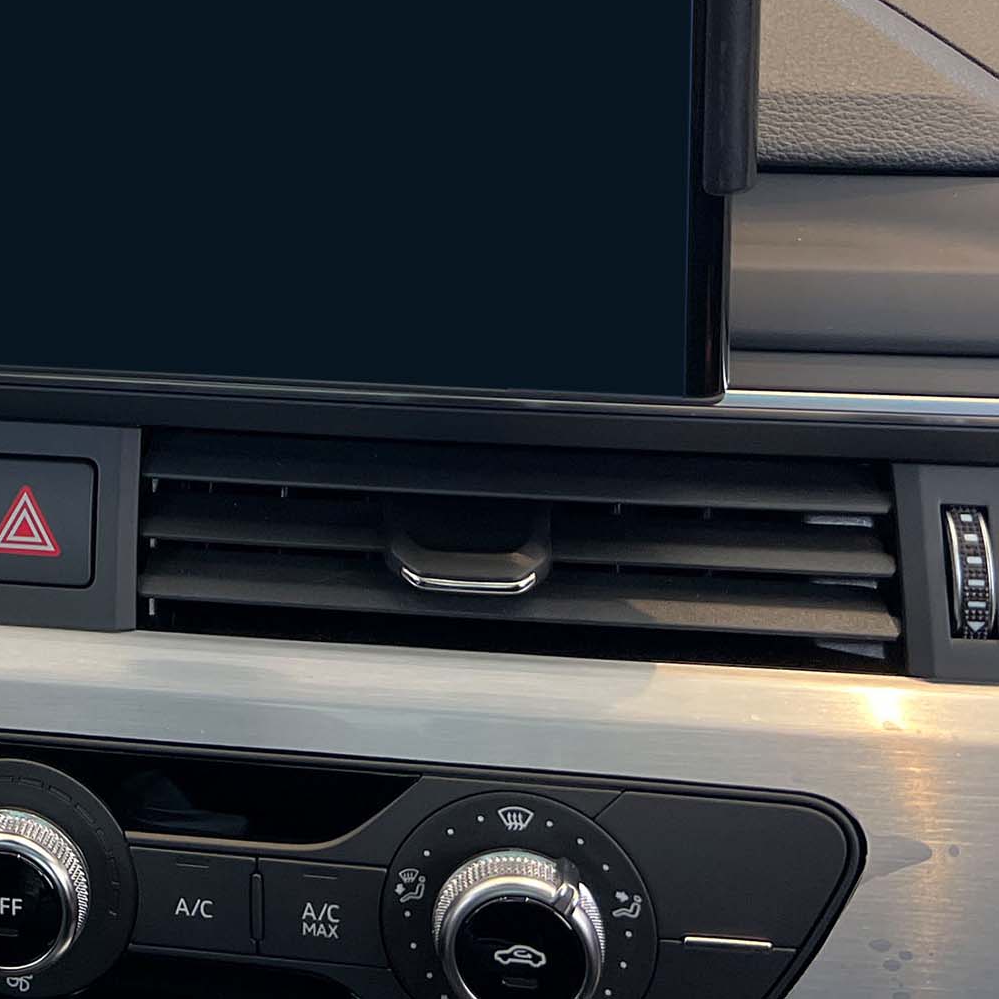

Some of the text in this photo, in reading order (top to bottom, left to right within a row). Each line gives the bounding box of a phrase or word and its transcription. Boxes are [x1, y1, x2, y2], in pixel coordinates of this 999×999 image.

[174, 897, 214, 918] A/C
[301, 902, 340, 923] A/C
[302, 921, 340, 939] MAX
